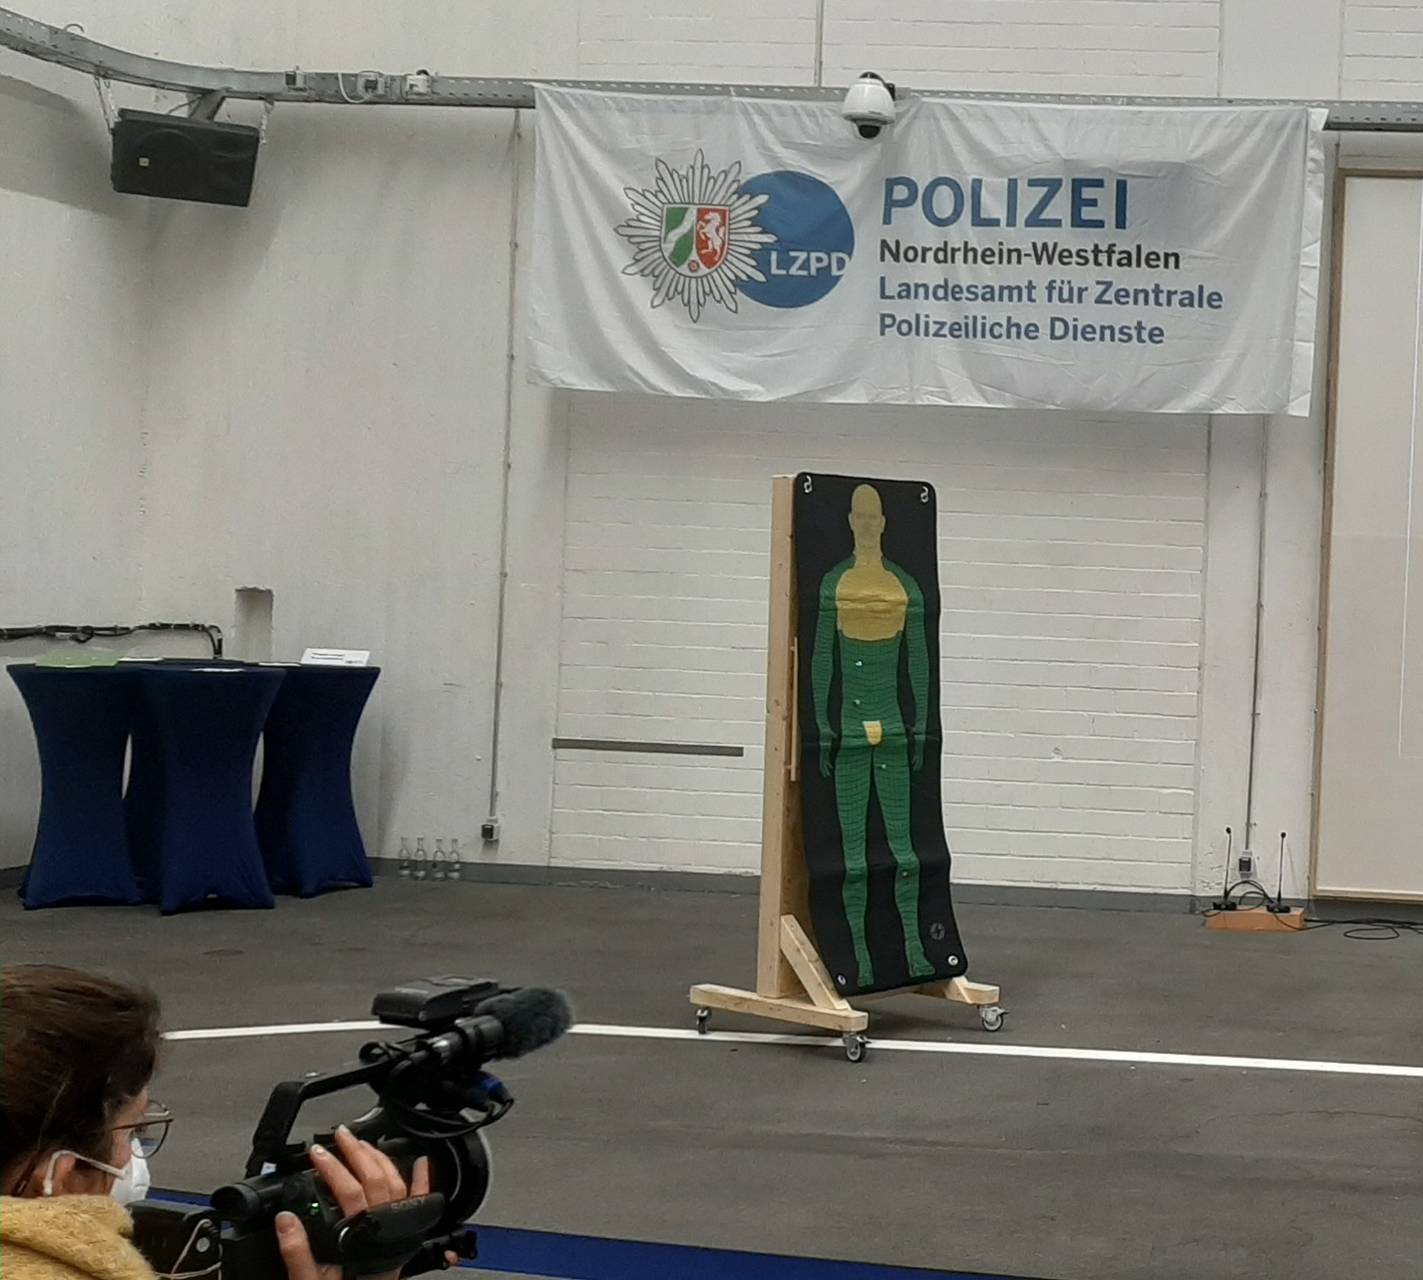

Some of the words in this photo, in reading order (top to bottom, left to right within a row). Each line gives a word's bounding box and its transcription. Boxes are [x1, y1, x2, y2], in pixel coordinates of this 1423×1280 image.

[881, 175, 1128, 230] POLIZEI
[770, 250, 850, 276] LZPD
[879, 238, 1182, 270] Nordrhein-Westfalen
[879, 275, 1037, 304] Landesamt
[1045, 279, 1088, 305] für
[1094, 280, 1224, 309] Zentrale
[879, 312, 1040, 341] Polizeiliche
[1049, 316, 1165, 345] Dienste
